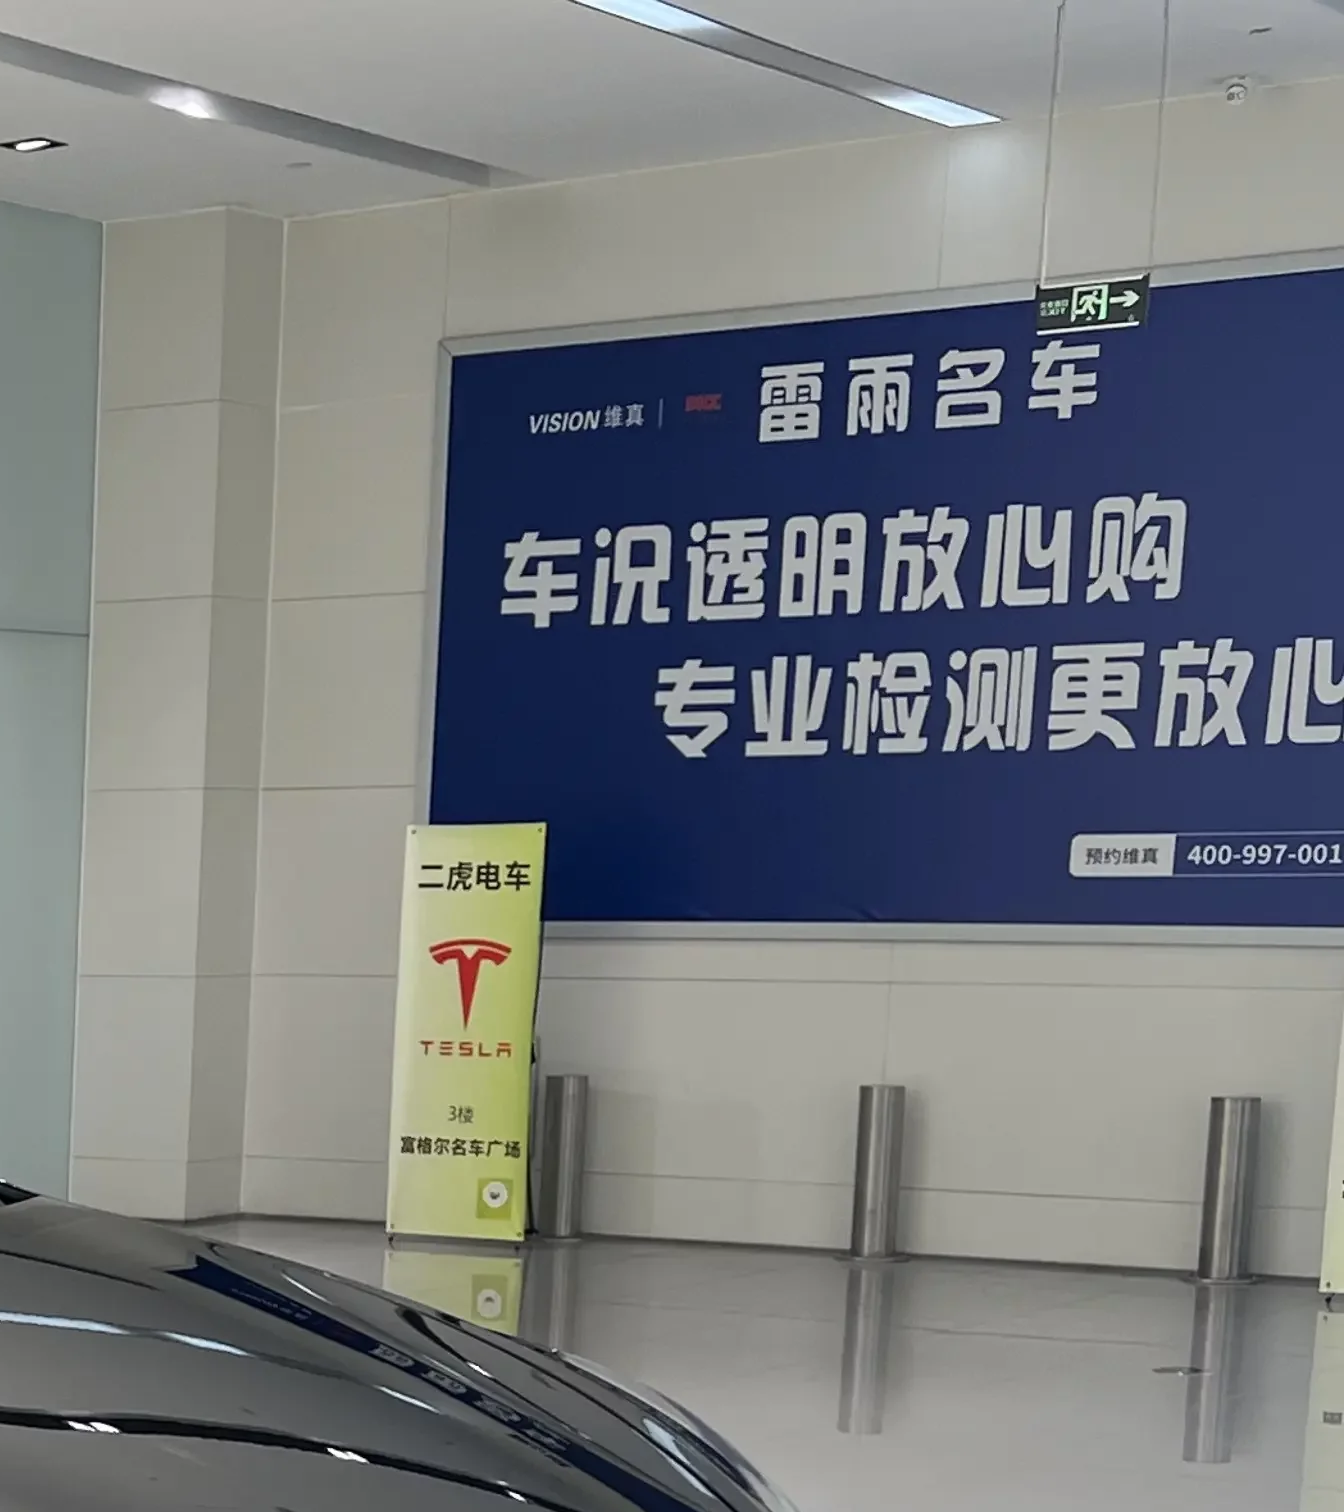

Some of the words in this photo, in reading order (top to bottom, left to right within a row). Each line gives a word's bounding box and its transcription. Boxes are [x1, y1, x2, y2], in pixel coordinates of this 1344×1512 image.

[758, 340, 1101, 443] 雷雨名车
[529, 409, 601, 434] VISION
[603, 403, 645, 428] 维真
[500, 492, 1187, 628] 车况透明放心购
[654, 637, 1344, 759] 专业检测更放心
[1085, 847, 1159, 866] 预约维真
[418, 861, 531, 892] 二虎电车
[420, 1040, 512, 1058] TESLA
[448, 1105, 474, 1124] 3楼
